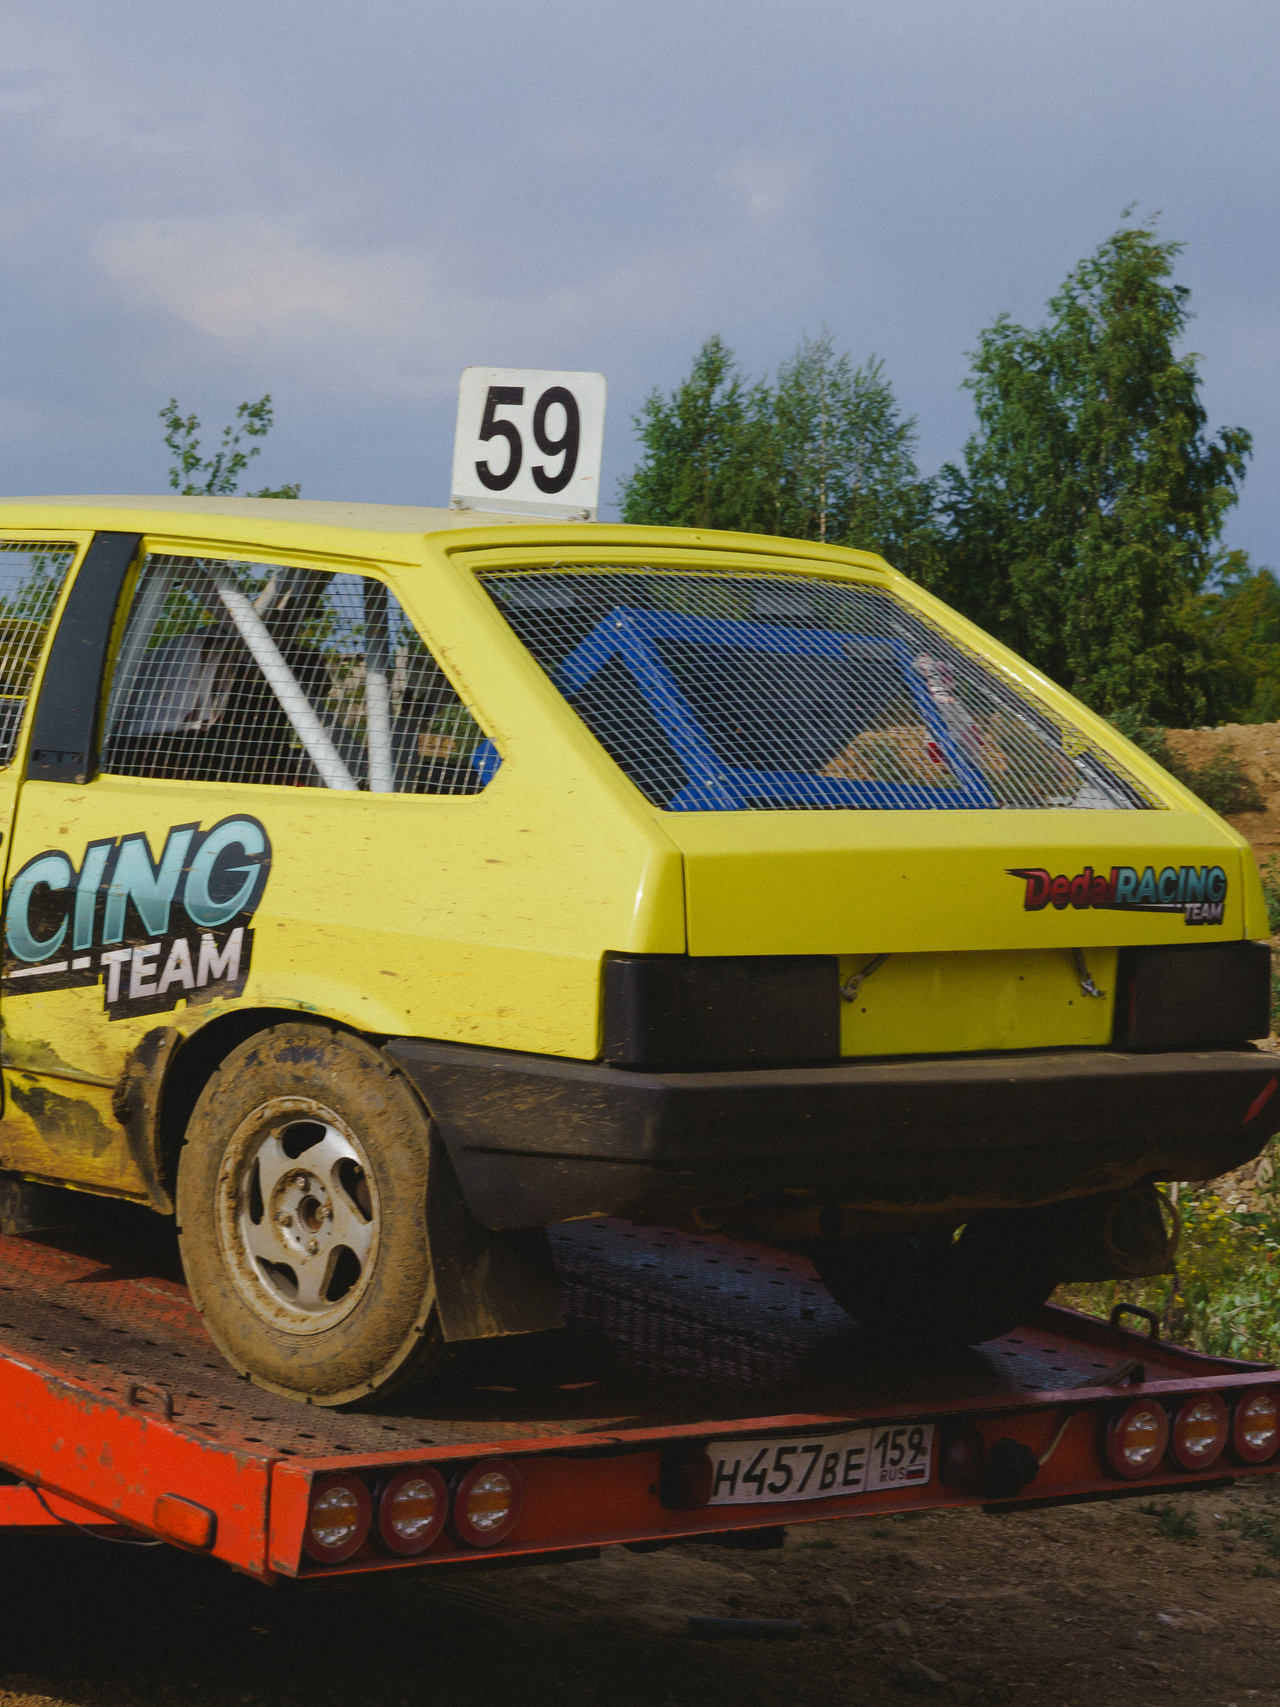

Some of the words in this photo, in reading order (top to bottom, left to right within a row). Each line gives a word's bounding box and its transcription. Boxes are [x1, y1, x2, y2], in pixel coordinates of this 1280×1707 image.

[475, 386, 580, 494] 59
[1184, 903, 1224, 921] TEAM
[100, 927, 244, 1003] TEAM
[874, 1428, 925, 1466] 159
[879, 1466, 907, 1483] RUS
